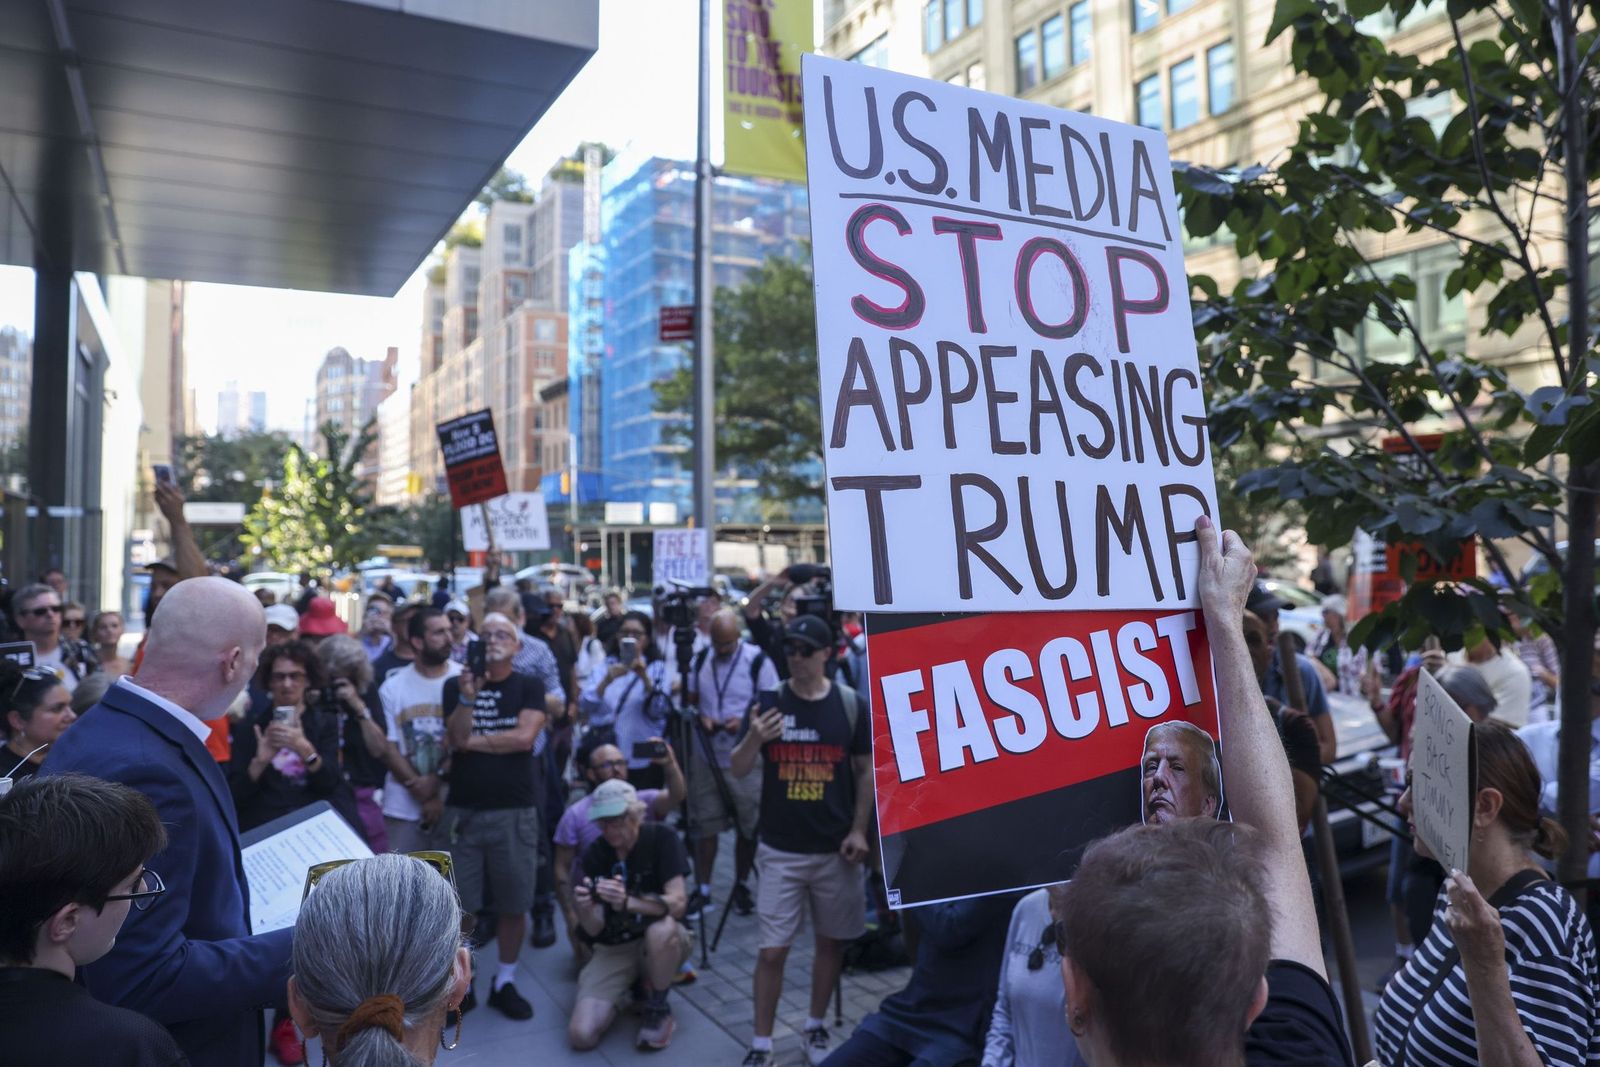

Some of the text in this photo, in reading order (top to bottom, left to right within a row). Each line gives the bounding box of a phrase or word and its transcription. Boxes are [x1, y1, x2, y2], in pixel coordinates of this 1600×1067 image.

[823, 75, 1172, 242] U.S. MEDIA
[845, 203, 1170, 354] STOP
[830, 336, 1207, 467] APPEASING
[654, 559, 705, 580] SPEECH
[655, 531, 703, 558] FREE
[831, 473, 1211, 605] TRUMP
[879, 611, 1202, 783] FASCIST
[1424, 684, 1455, 746] BRING
[778, 762, 834, 782] NOTHING
[786, 781, 825, 801] LESS!
[1426, 735, 1453, 789] BACK
